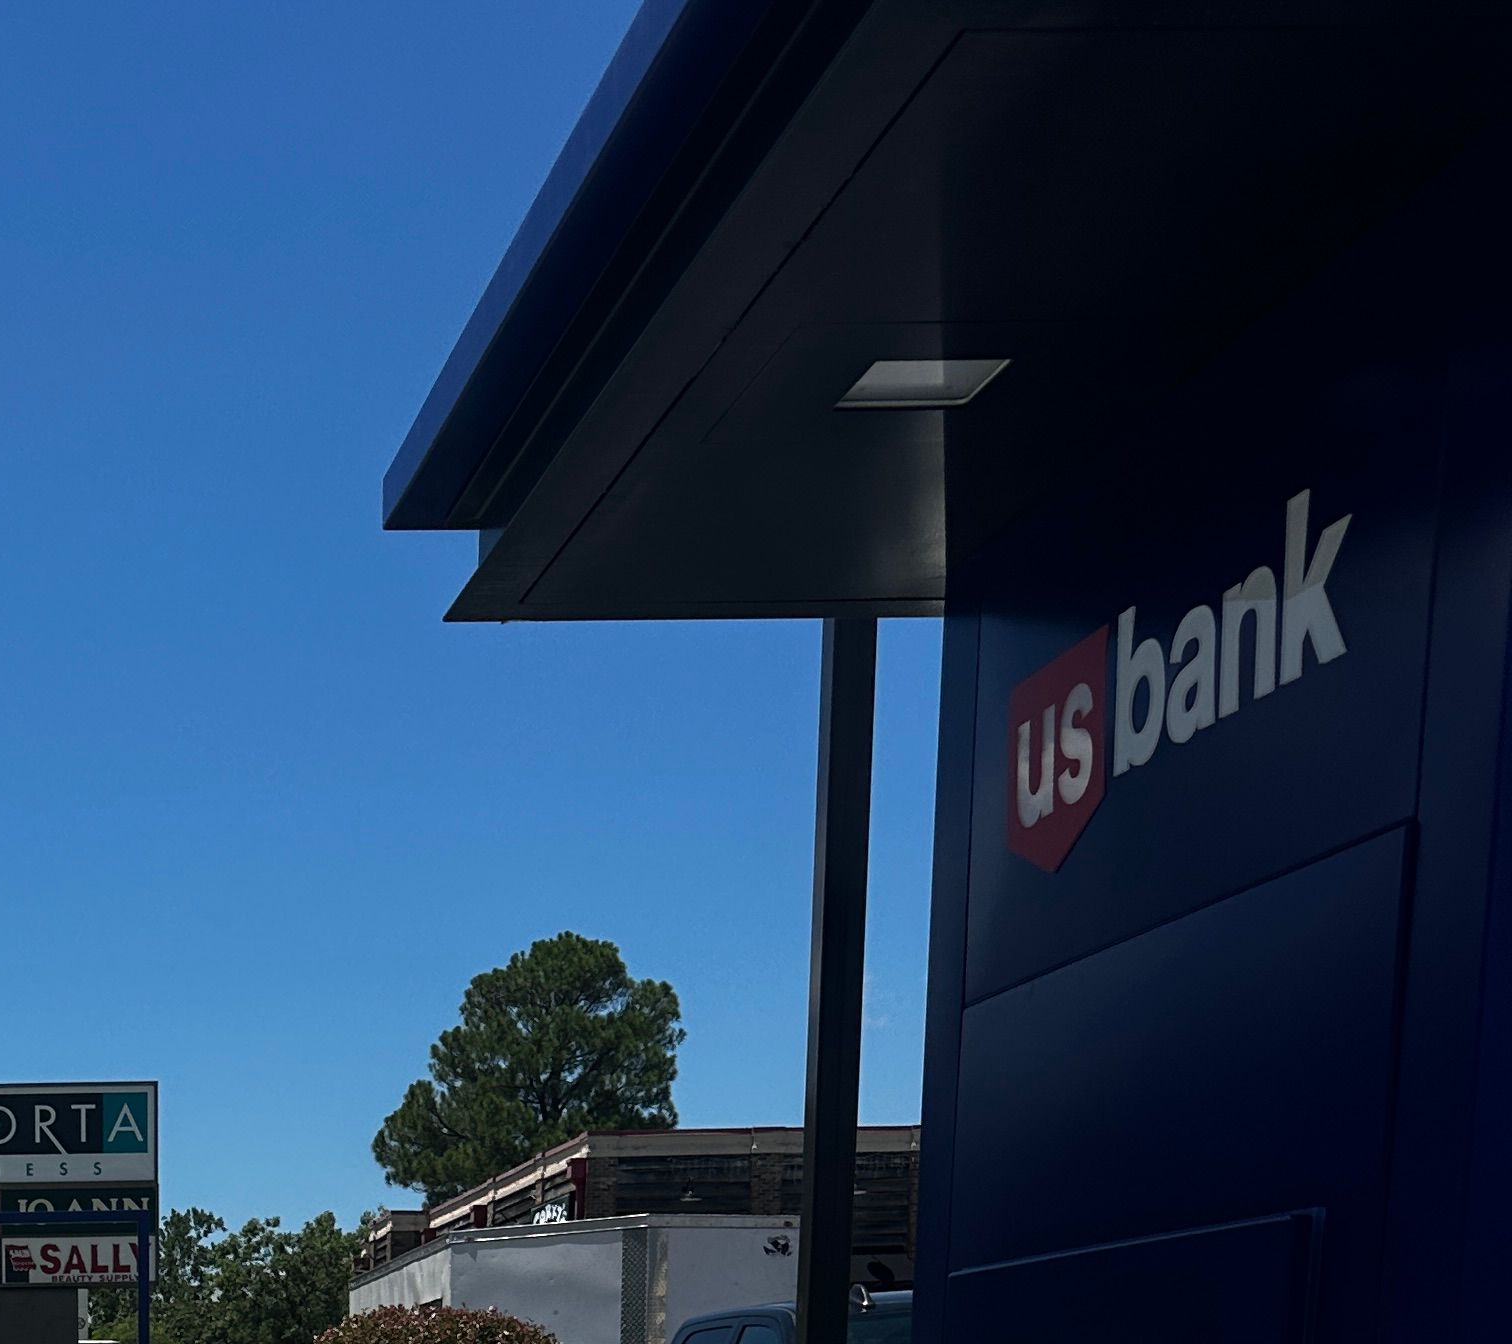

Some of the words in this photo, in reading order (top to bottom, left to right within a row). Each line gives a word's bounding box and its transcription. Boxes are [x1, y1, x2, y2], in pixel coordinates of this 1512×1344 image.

[1016, 683, 1094, 828] us
[1113, 489, 1353, 777] bank
[51, 1275, 93, 1283] BEAUTY
